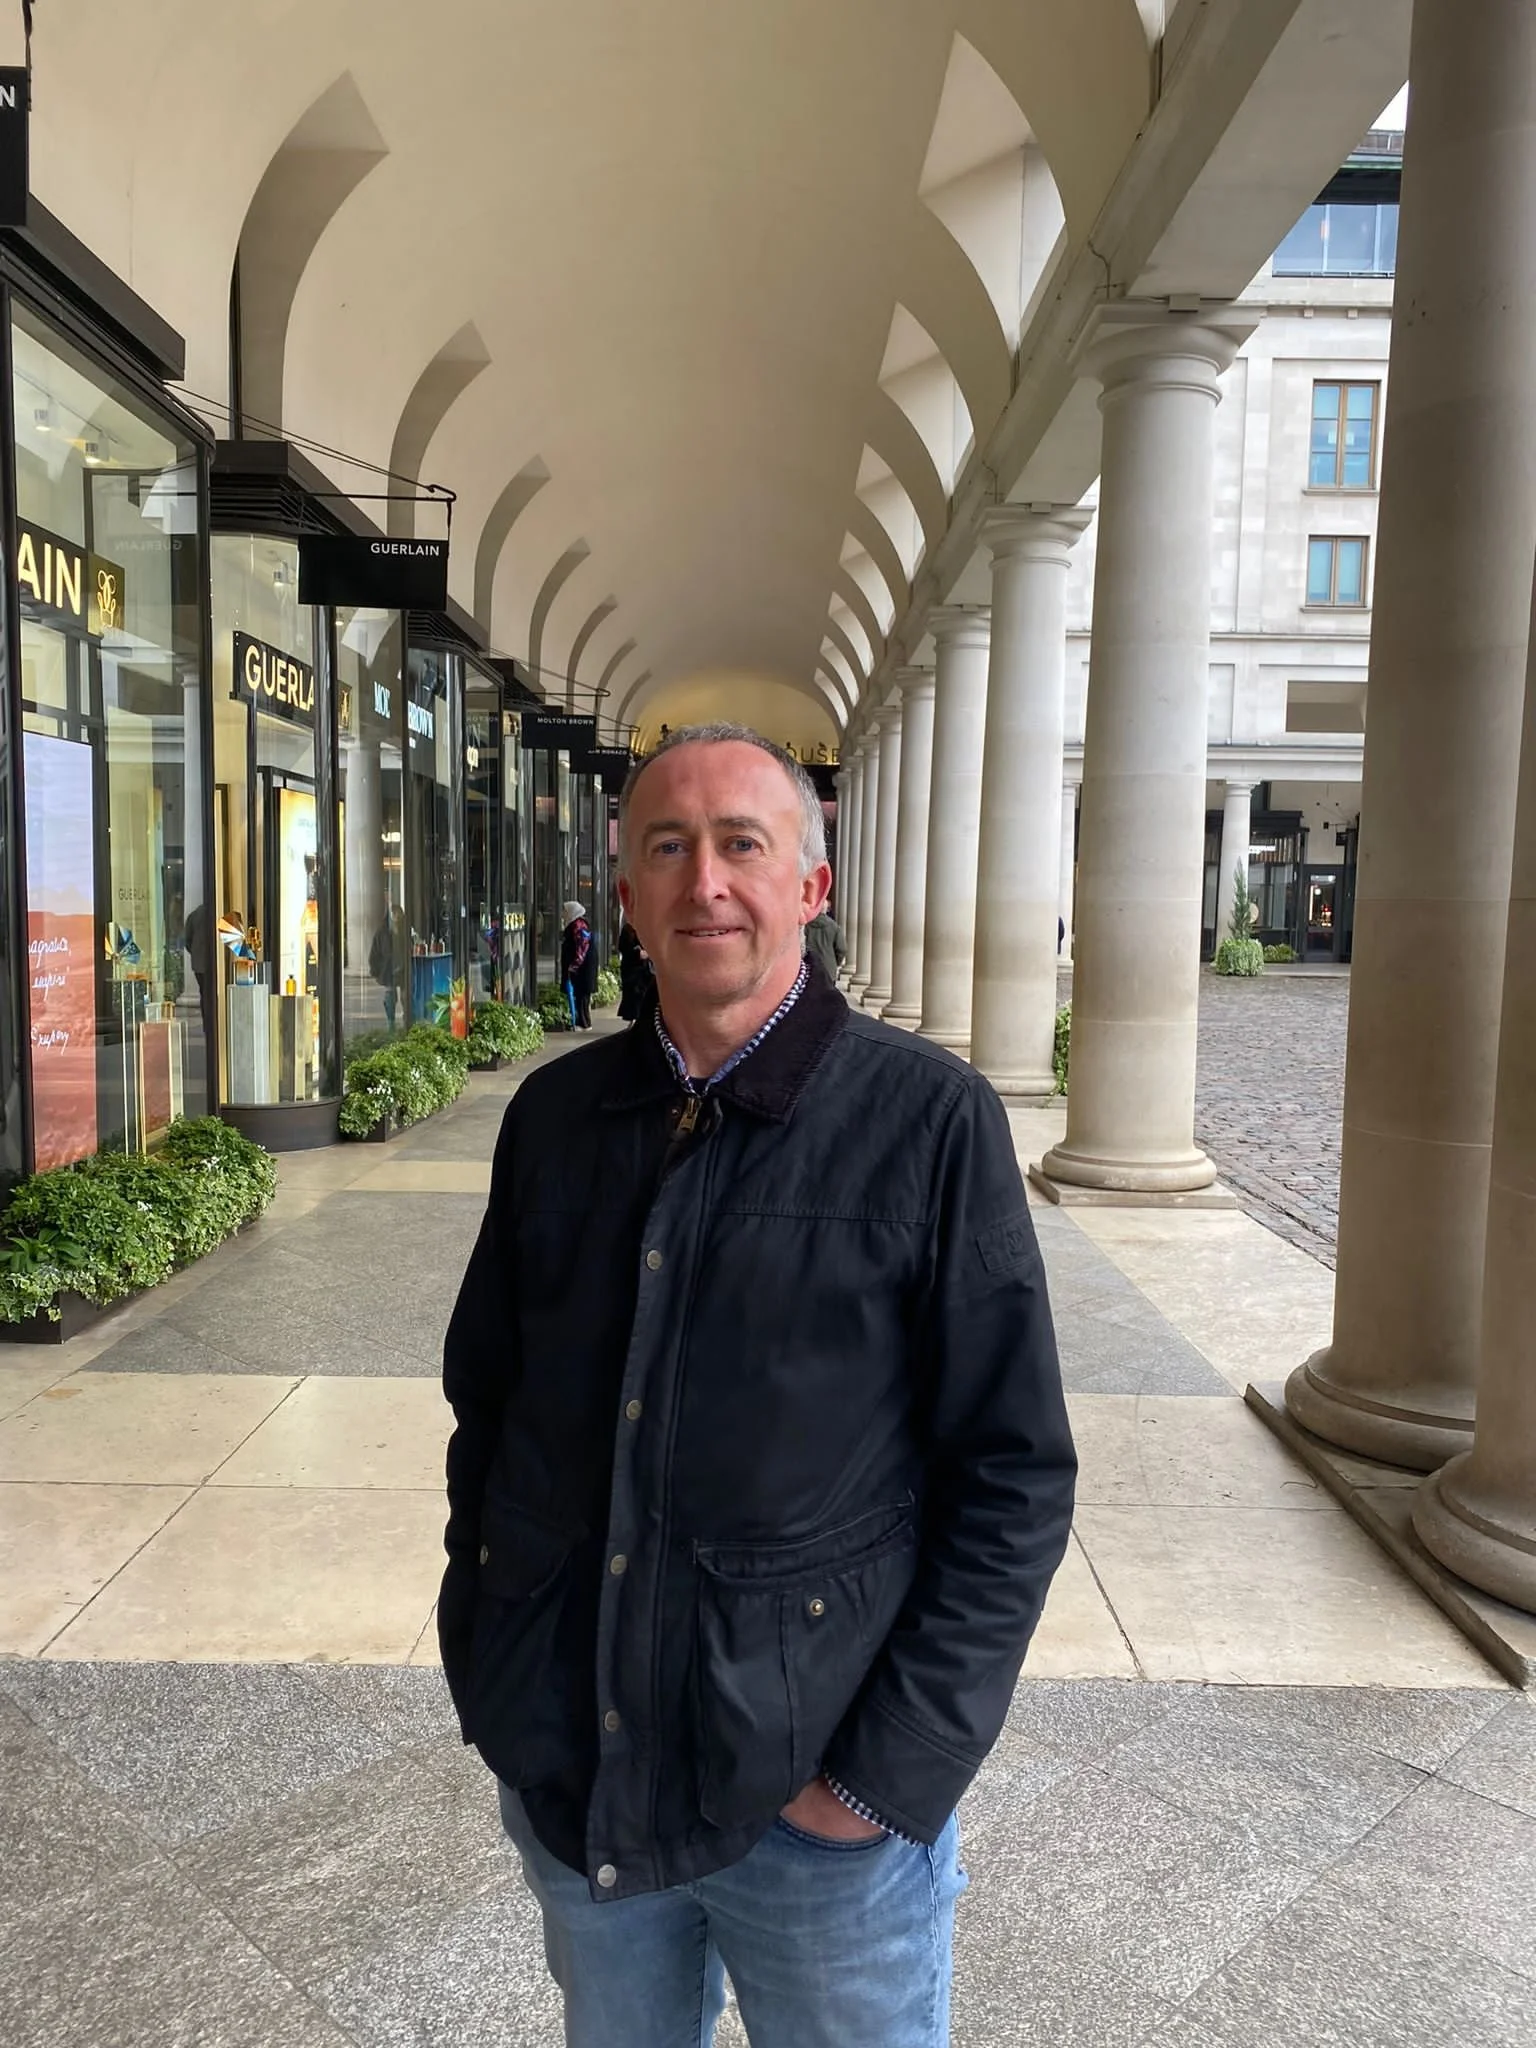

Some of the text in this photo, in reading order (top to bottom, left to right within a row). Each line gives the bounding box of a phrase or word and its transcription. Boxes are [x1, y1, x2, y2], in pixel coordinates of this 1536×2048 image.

[0, 85, 16, 108] N
[370, 542, 440, 556] GUERLAIN
[18, 532, 81, 616] AIN
[245, 644, 315, 712] GUERLA
[537, 717, 567, 725] MOLTON
